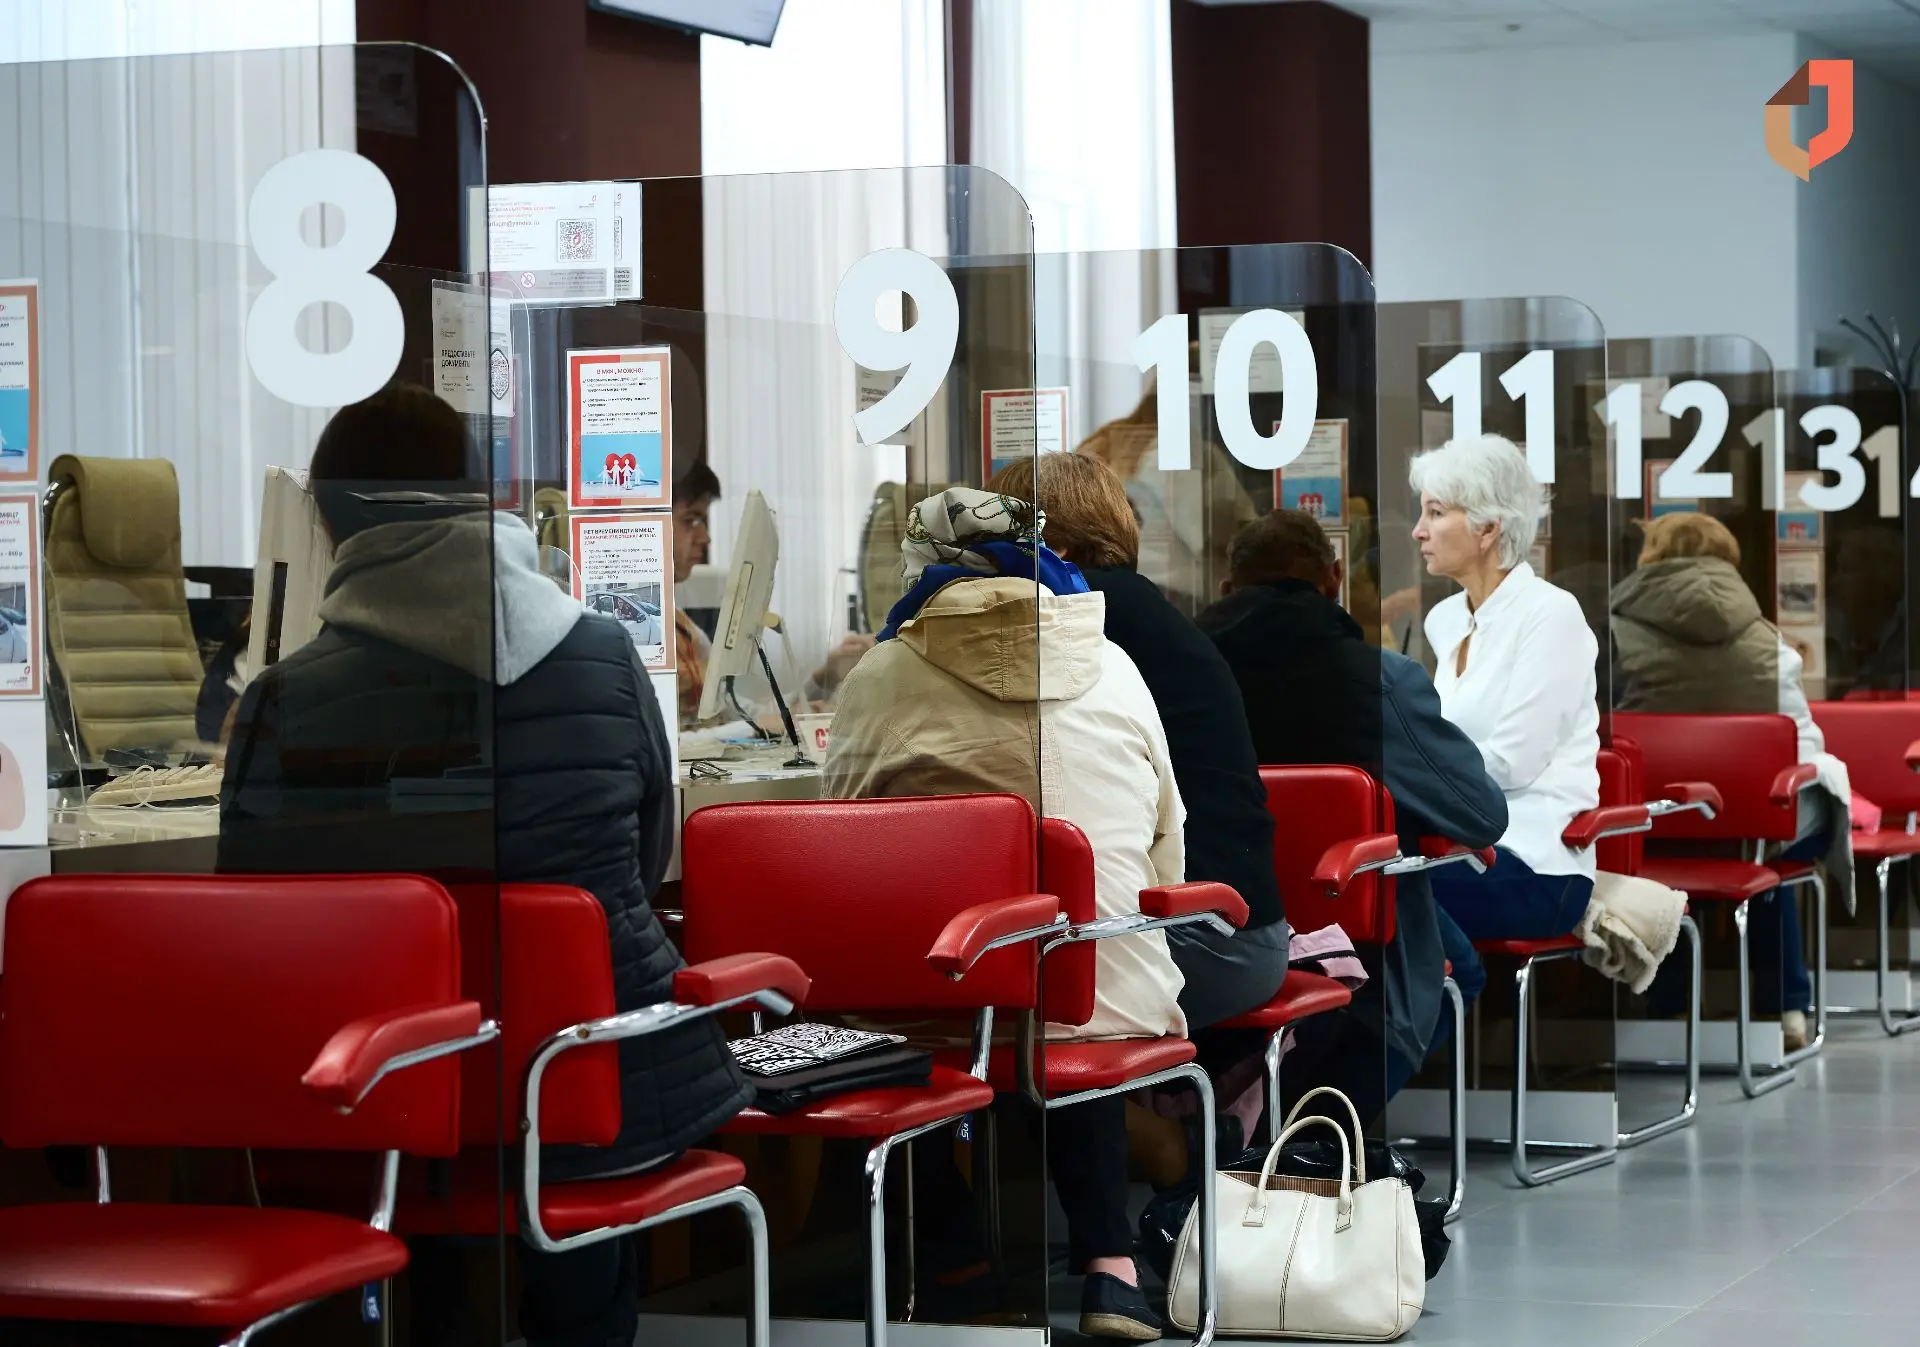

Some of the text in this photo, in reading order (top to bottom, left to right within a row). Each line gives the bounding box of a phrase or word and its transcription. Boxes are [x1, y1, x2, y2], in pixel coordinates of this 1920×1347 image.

[245, 150, 405, 407] 8
[833, 247, 960, 447] 9
[1128, 308, 1318, 470] 10
[1427, 350, 1555, 483] 11
[1593, 380, 1733, 499] 12
[1741, 405, 1866, 511] 13
[1860, 425, 1920, 518] 1
